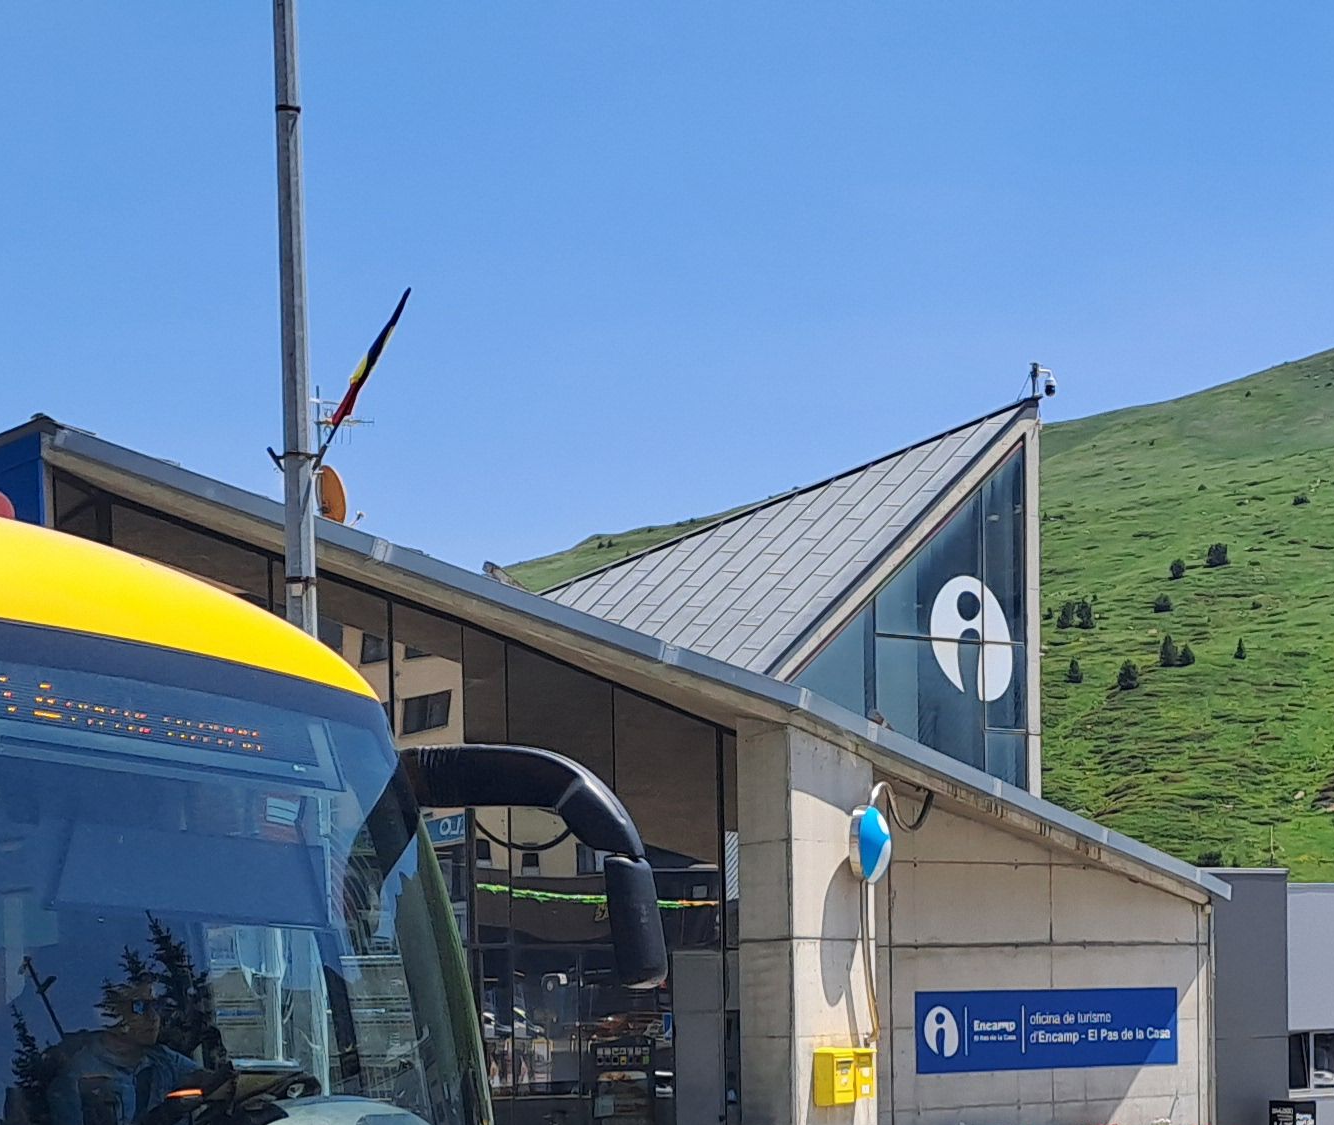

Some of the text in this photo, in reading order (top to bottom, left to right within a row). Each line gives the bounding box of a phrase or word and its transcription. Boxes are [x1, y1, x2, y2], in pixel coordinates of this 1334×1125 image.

[1029, 1011, 1112, 1025] oficina de turisme
[973, 1019, 1016, 1033] Encamp
[1029, 1030, 1079, 1045] d'Encamp
[1088, 1029, 1098, 1041] El
[1100, 1029, 1118, 1041] Pas
[1121, 1028, 1133, 1040] de
[1135, 1028, 1144, 1040] la
[1146, 1027, 1171, 1039] Casa
